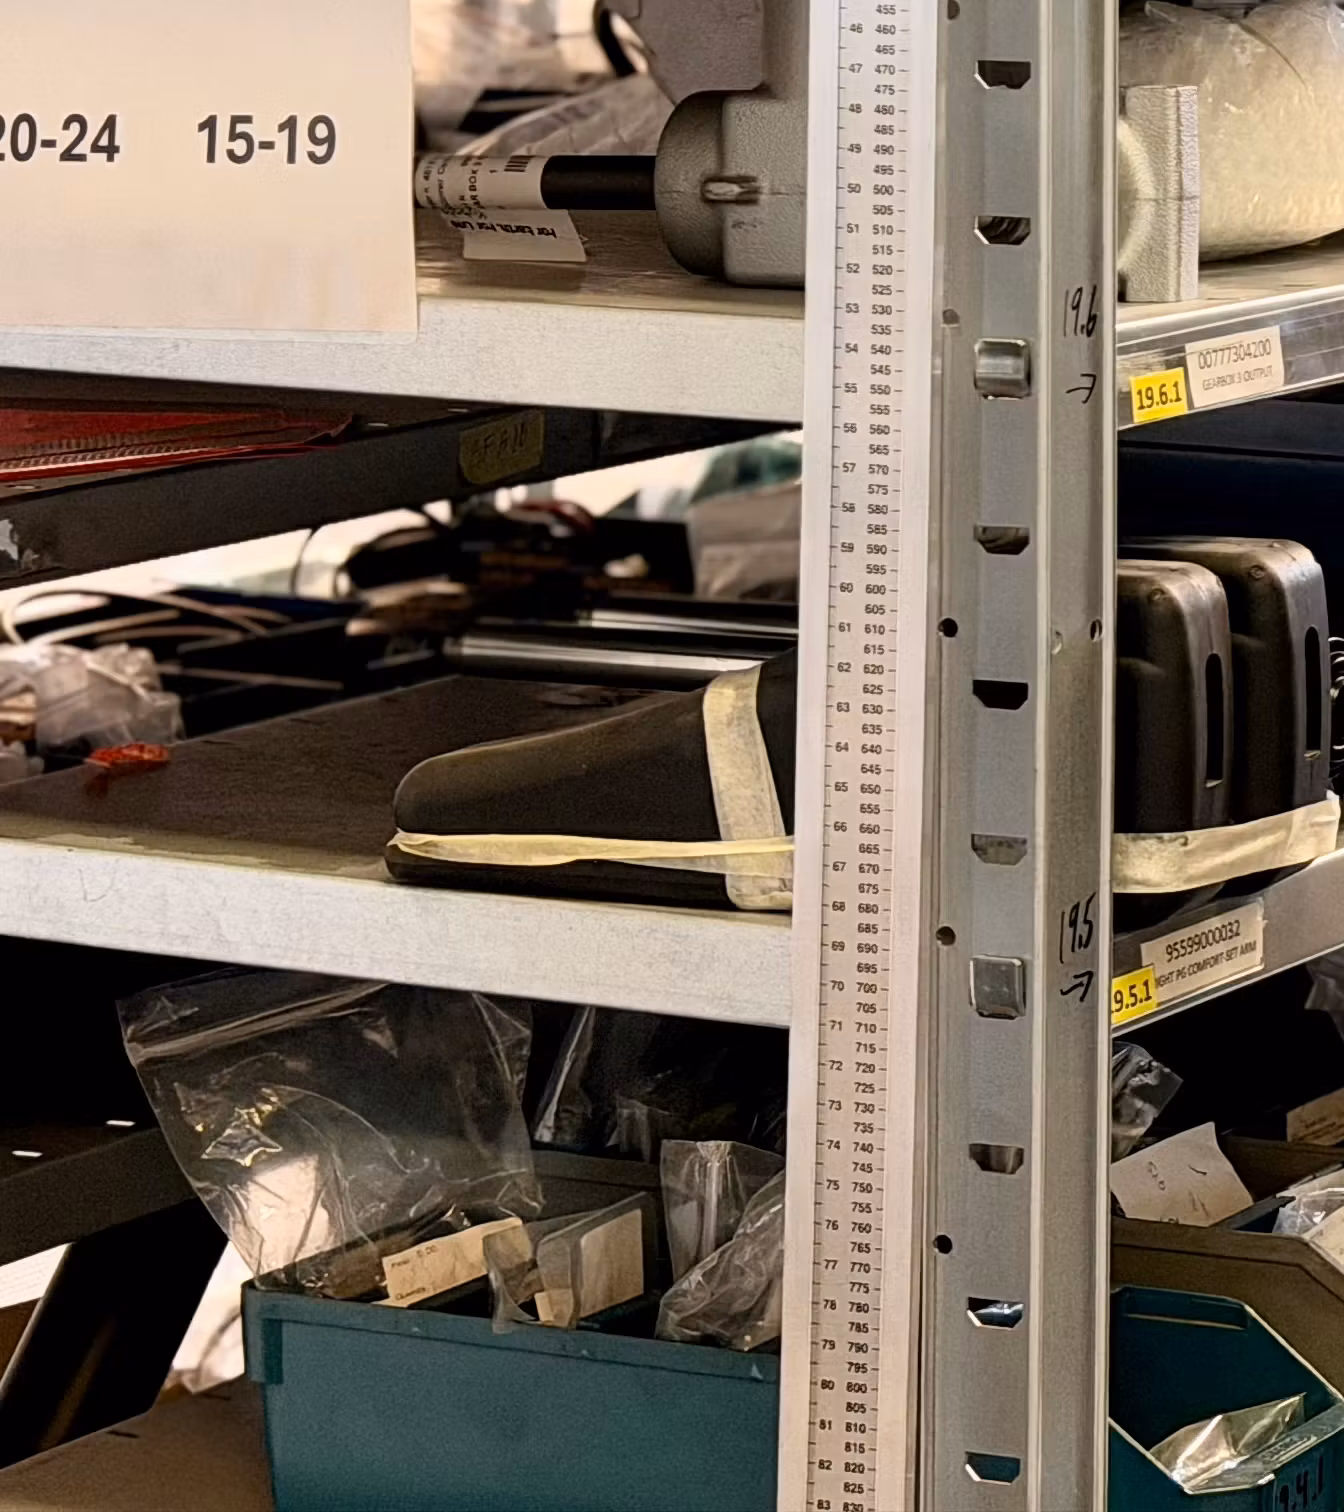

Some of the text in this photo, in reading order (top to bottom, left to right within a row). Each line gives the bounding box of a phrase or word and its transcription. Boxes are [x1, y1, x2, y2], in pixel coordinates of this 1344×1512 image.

[848, 62, 896, 76] 47 470
[847, 103, 895, 116] 48 480
[0, 113, 121, 165] 0-24
[196, 113, 338, 167] 15-19
[846, 182, 895, 196] 50 500
[846, 222, 894, 236] 51 510
[844, 302, 893, 316] 53 530
[1063, 284, 1098, 338] 19.6
[1136, 380, 1183, 411] 19.6.1
[842, 422, 891, 436] 56 560
[841, 461, 890, 476] 57 570
[840, 541, 888, 556] 59 590
[838, 581, 887, 596] 60 600
[836, 661, 885, 676] 62 620
[835, 701, 884, 716] 63 630
[833, 781, 882, 796] 65 650
[831, 900, 880, 915] 68 680
[1058, 891, 1097, 965] 19.5
[830, 940, 879, 955] 69 690
[1111, 978, 1153, 1014] 9.5.1
[828, 1019, 878, 1035] 71 710
[825, 1059, 876, 1075] 72 720
[825, 1138, 875, 1155] 74 740
[825, 1178, 874, 1195] 75 750
[822, 1258, 872, 1275] 77 770
[822, 1298, 870, 1314] 78 780
[820, 1378, 868, 1395] 80 800
[818, 1418, 867, 1435] 81 810
[816, 1498, 832, 1511] 83
